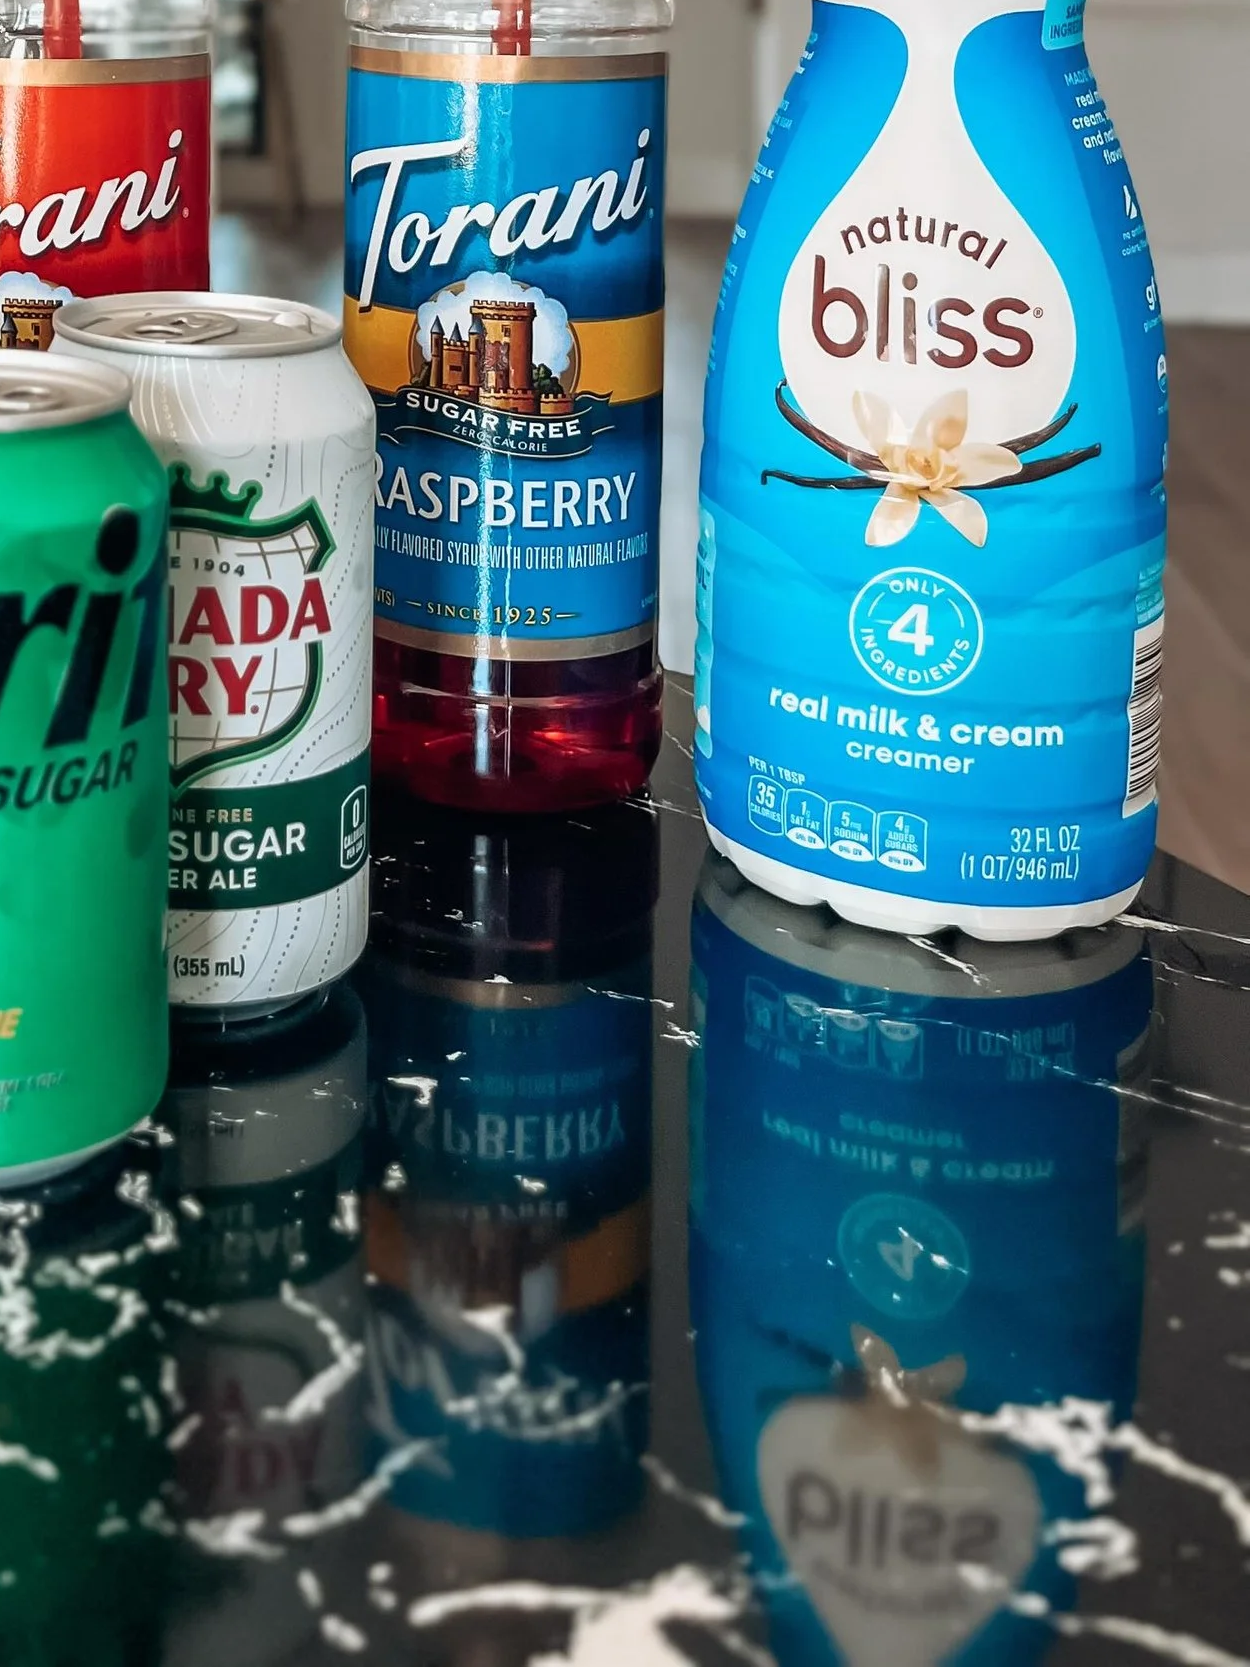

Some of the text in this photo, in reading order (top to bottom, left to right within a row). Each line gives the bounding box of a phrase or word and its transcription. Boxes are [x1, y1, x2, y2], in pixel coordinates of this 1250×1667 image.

[350, 128, 651, 313] Torani
[840, 206, 1008, 270] natural
[810, 254, 1035, 369] bliss
[405, 391, 581, 439] SUGAR FREE
[492, 435, 548, 453] CALORIE
[391, 530, 443, 562] FLAVORED
[490, 545, 521, 571] WITH
[526, 545, 564, 571] OTHER
[567, 541, 615, 569] NATURAL
[193, 558, 246, 577] 1904
[888, 577, 946, 599] ONLY
[168, 577, 332, 645] ADA
[427, 601, 552, 626] SINCE 1925
[887, 603, 935, 657] 4
[860, 628, 970, 684] INGREDIENTS
[768, 686, 1064, 747] real milk & cream
[748, 755, 805, 785] PER 1 TBSP
[845, 739, 975, 775] creamer
[755, 782, 777, 809] 35
[206, 808, 253, 823] FREE
[750, 803, 782, 823] CALORIES
[790, 814, 820, 831] SAT FAT
[168, 822, 307, 863] SUGAR
[833, 827, 869, 844] SODIUM
[884, 839, 919, 853] SUGARS
[887, 830, 916, 843] ADDED
[1010, 825, 1081, 853] 32 FL OZ
[208, 867, 257, 890] ALE
[960, 852, 1080, 882] (1 QT/946 mL)
[173, 954, 246, 978] (355 mL)
